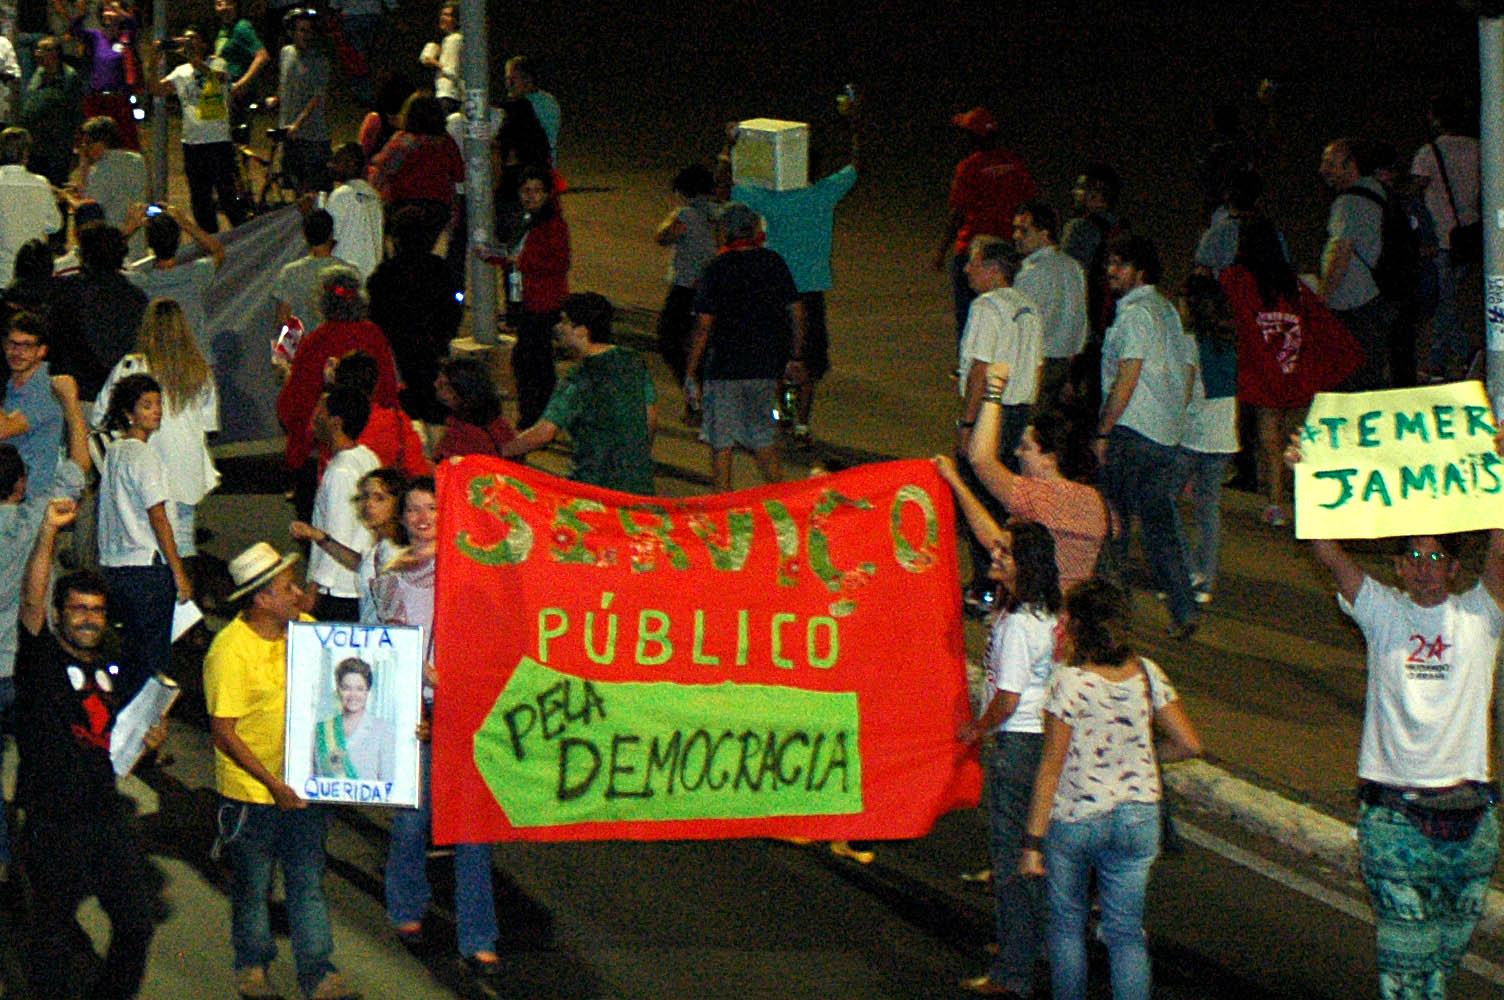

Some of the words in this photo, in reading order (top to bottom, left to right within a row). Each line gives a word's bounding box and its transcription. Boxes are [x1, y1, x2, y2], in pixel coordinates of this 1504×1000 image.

[454, 473, 939, 617] SERVIÇO
[313, 626, 393, 648] VOLTA
[538, 592, 840, 669] PÚBLICO
[502, 678, 607, 761] PELA
[557, 730, 850, 802] DEMOCRACIA
